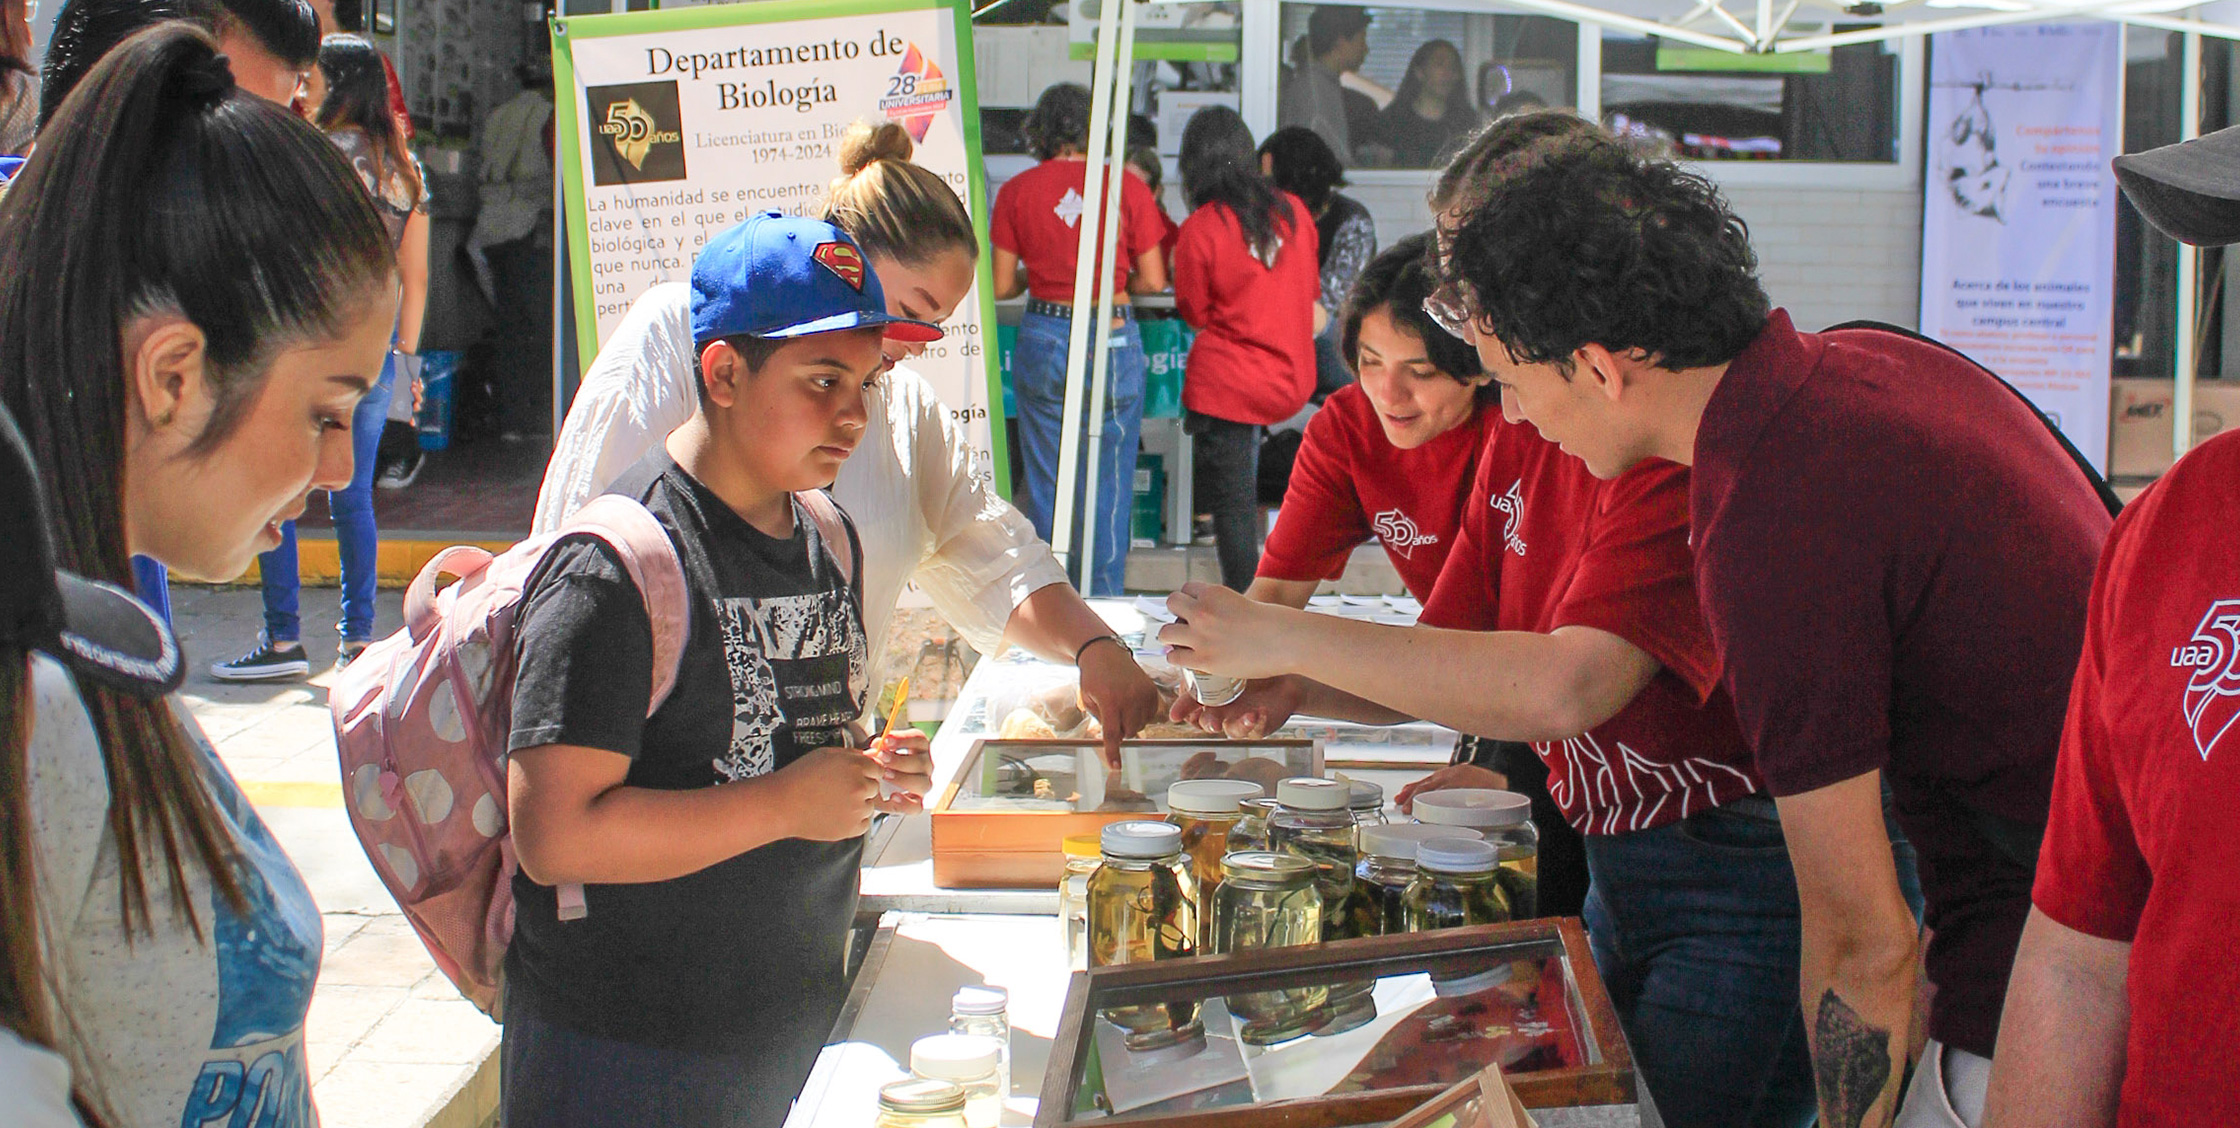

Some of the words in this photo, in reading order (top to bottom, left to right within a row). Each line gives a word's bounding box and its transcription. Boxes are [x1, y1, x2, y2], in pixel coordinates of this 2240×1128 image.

[646, 37, 859, 80] Departamento
[870, 29, 904, 58] de
[717, 78, 837, 113] Biología
[881, 91, 950, 109] UNIVERSITARIA
[695, 129, 793, 148] Licenciatura
[798, 129, 817, 141] en
[752, 144, 832, 164] 1974-2024
[588, 197, 606, 212] La
[613, 188, 704, 210] humanidad
[711, 190, 729, 202] se
[737, 182, 820, 201] encuentra
[590, 217, 632, 232] clave
[642, 217, 661, 228] en
[671, 211, 685, 226] el
[694, 211, 725, 226] que
[734, 206, 748, 220] el
[592, 235, 665, 253] biológica
[675, 236, 684, 251] y
[694, 231, 707, 245] el
[593, 260, 624, 274] que
[631, 257, 684, 272] nunca.
[596, 281, 625, 295] una
[960, 340, 980, 356] de
[2169, 645, 2214, 667] uaa
